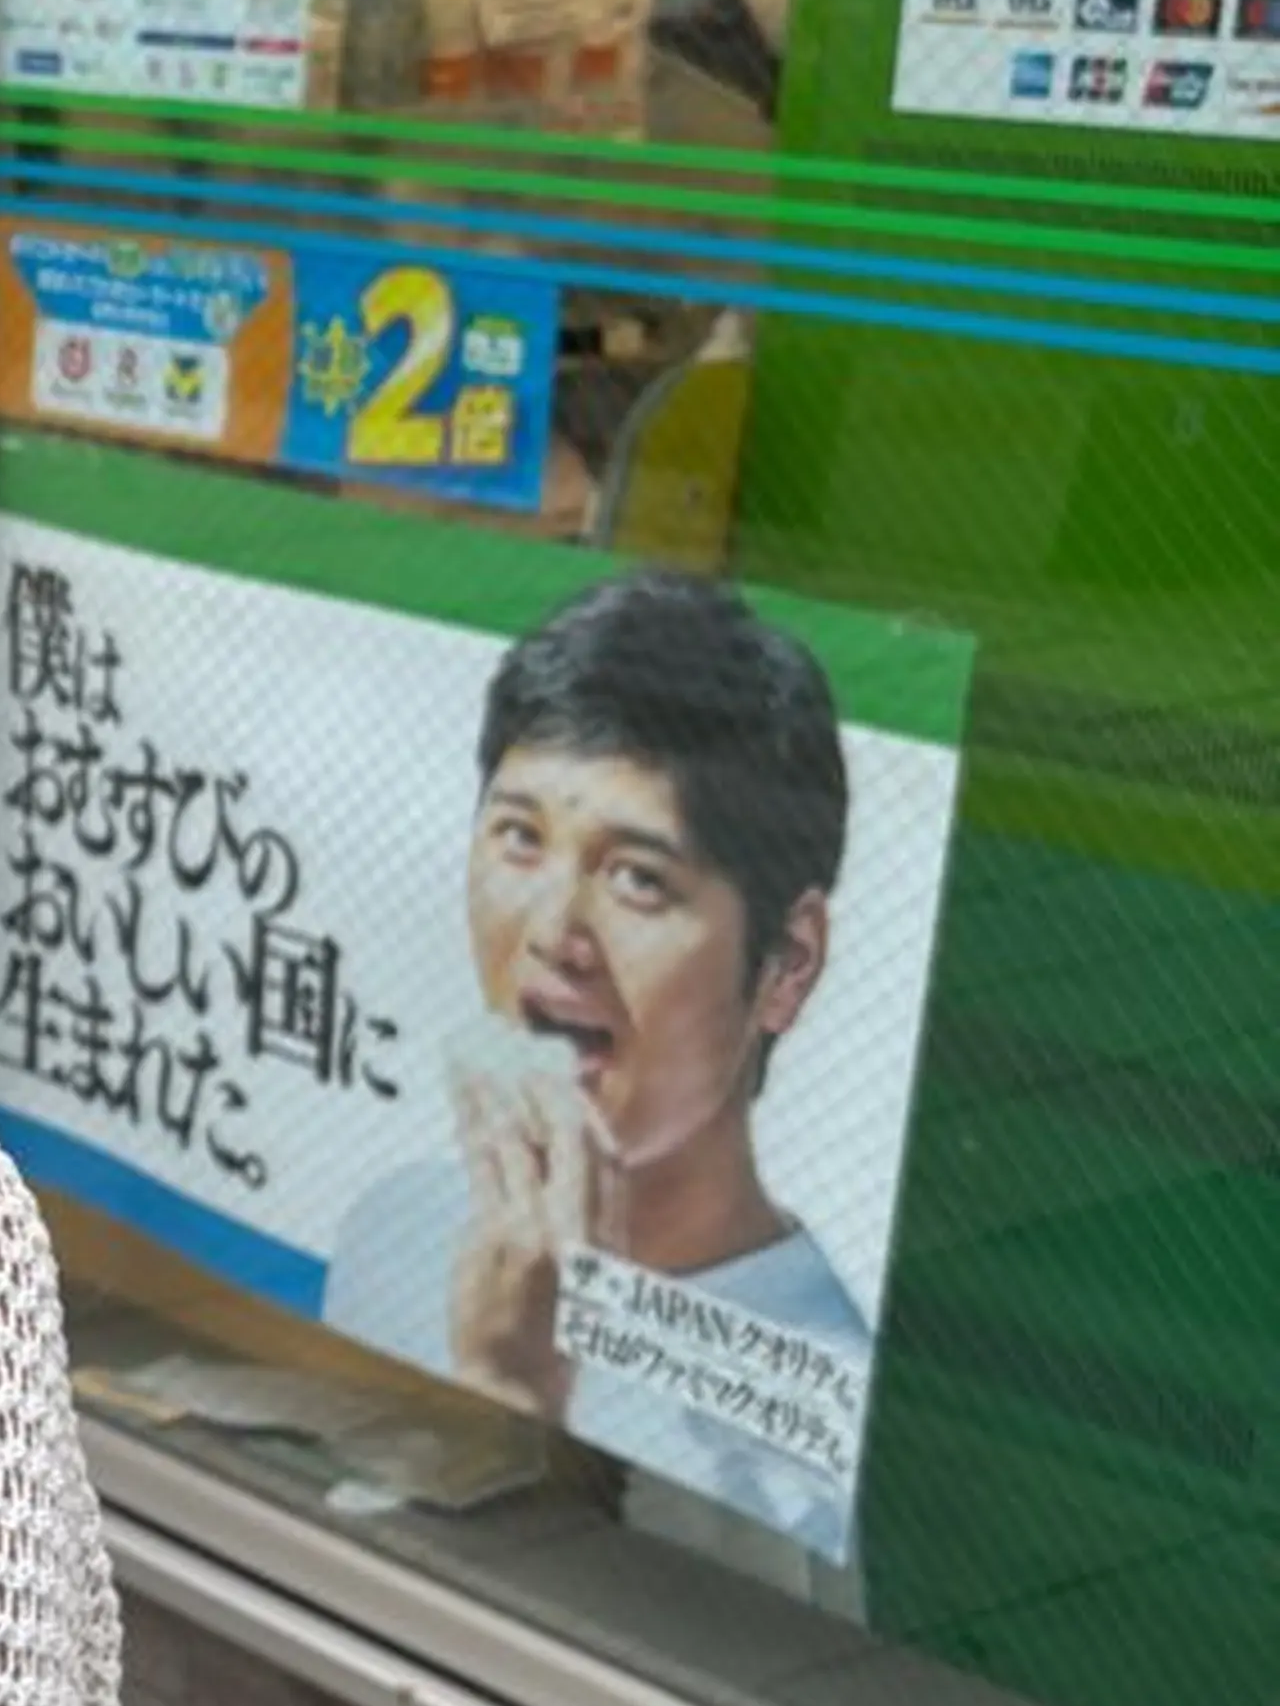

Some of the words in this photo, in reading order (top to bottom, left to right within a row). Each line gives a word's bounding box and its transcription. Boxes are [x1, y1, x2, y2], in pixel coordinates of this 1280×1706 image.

[6, 561, 122, 724] 僕は
[3, 707, 300, 920] おむすびの
[0, 831, 399, 1101] おいしい国に
